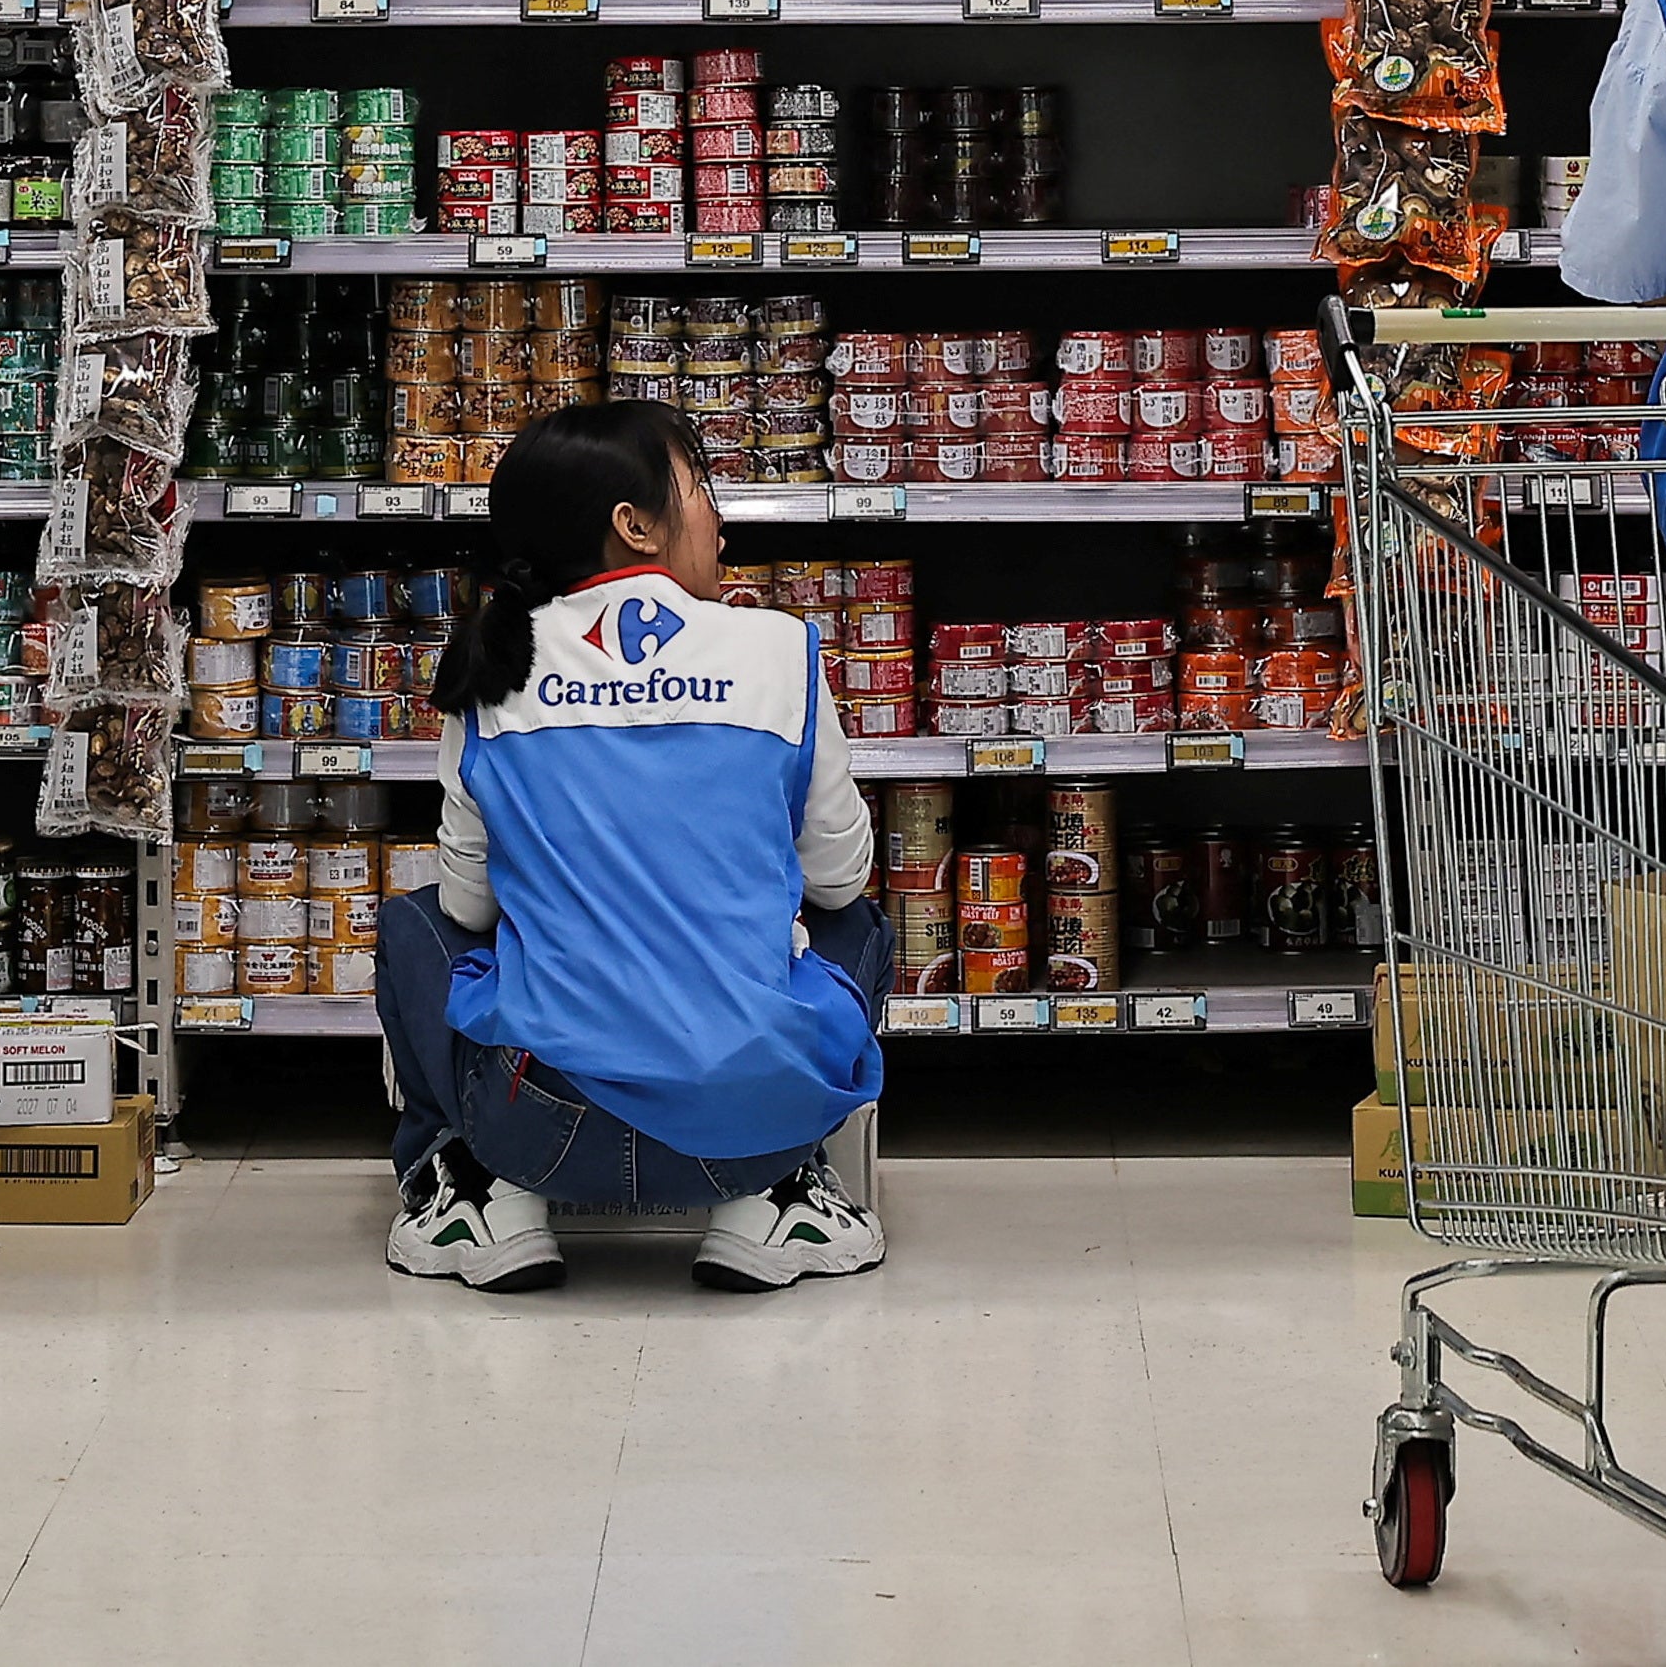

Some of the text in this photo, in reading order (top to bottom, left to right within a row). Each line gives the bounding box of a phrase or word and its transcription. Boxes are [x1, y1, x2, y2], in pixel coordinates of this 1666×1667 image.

[339, 0, 356, 10] 84
[497, 245, 514, 256] 59
[252, 495, 270, 506] 93
[386, 495, 402, 506] 93
[856, 497, 872, 508] 99
[538, 667, 734, 708] Carrefour
[321, 755, 339, 768] 99
[999, 1008, 1016, 1020] 59
[1075, 1008, 1099, 1020] 135
[1155, 1006, 1172, 1019] 42
[1316, 1002, 1333, 1015] 49
[2, 1046, 29, 1056] SOFT
[30, 1045, 66, 1055] MELON
[16, 1098, 78, 1116] 2027 07 04
[1378, 1168, 1423, 1181] KUAG
